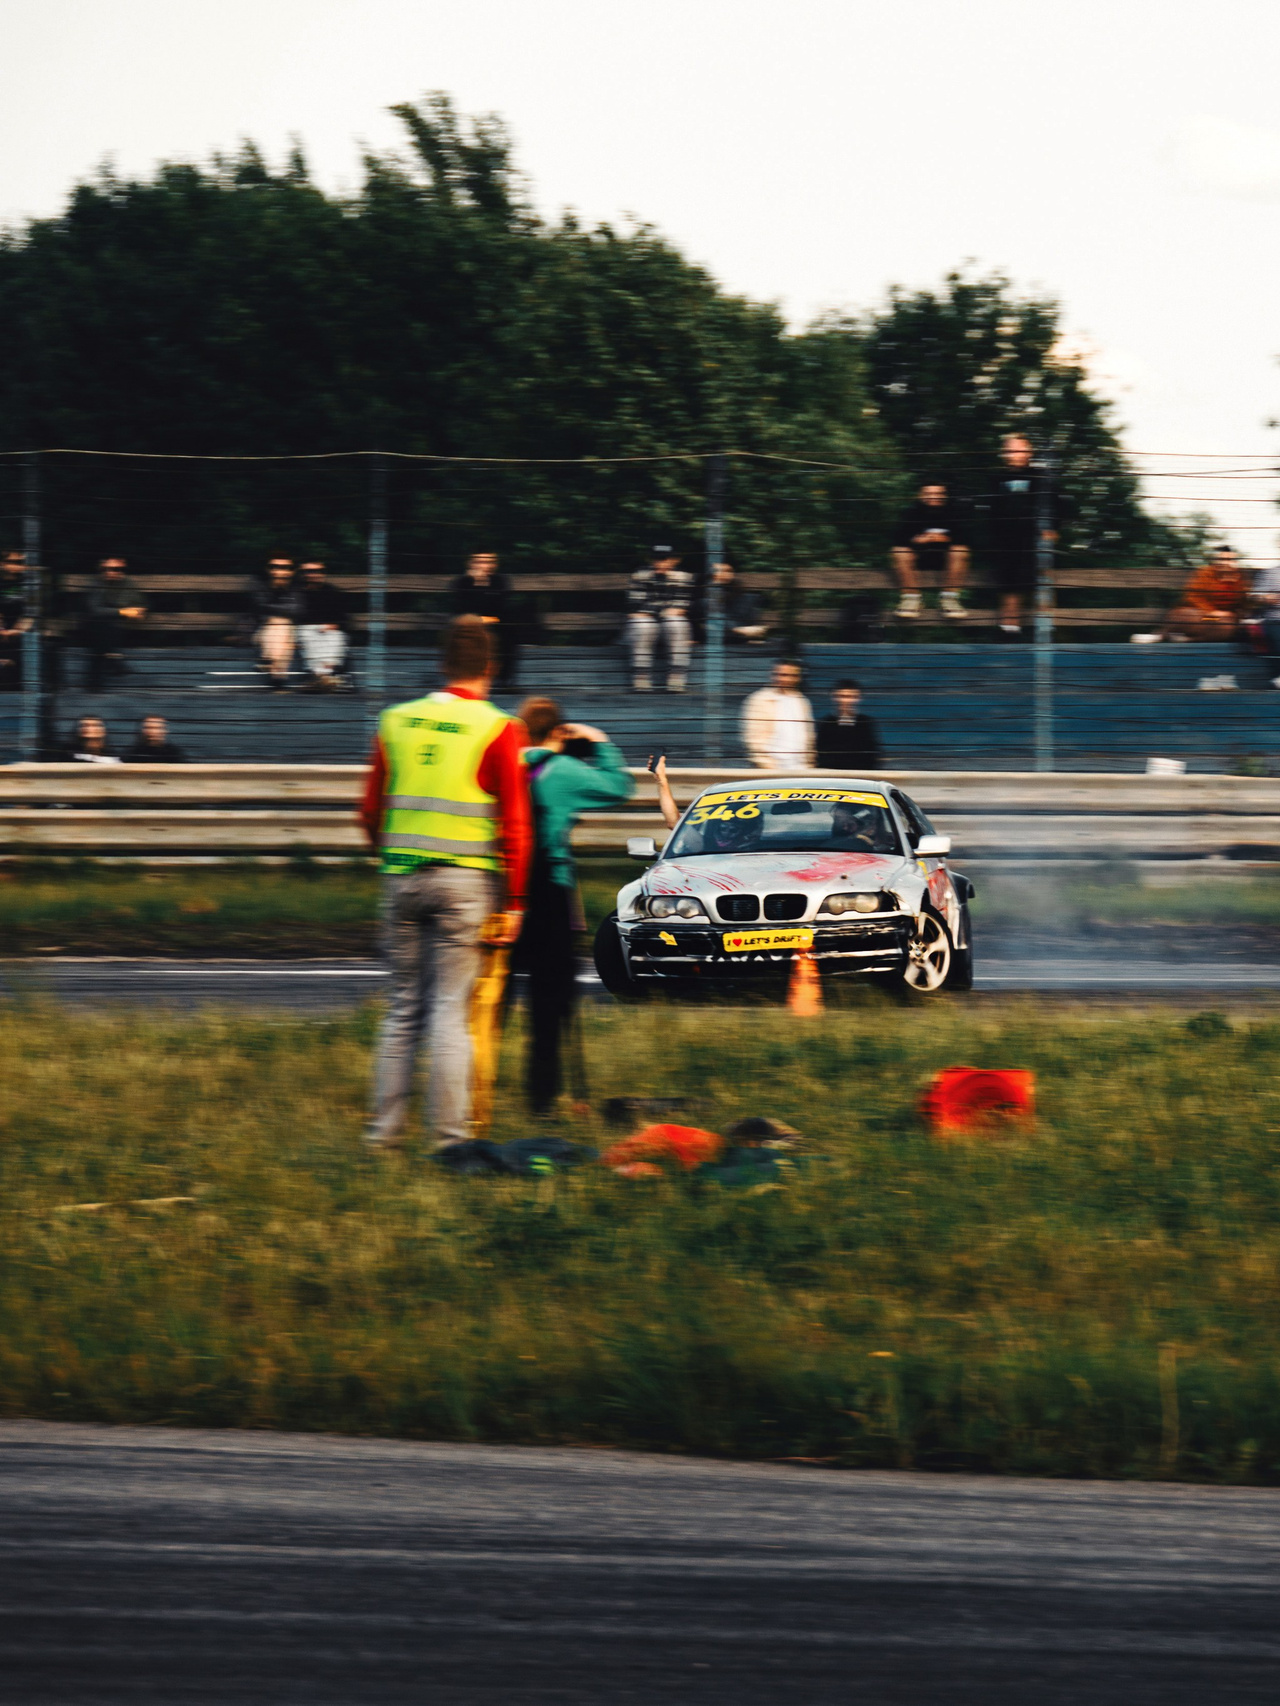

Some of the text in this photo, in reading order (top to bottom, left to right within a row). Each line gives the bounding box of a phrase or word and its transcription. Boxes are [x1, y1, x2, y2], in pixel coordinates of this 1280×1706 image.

[725, 792, 849, 802] LET'S DRIFT
[685, 802, 761, 825] 346
[744, 936, 770, 945] LET'S
